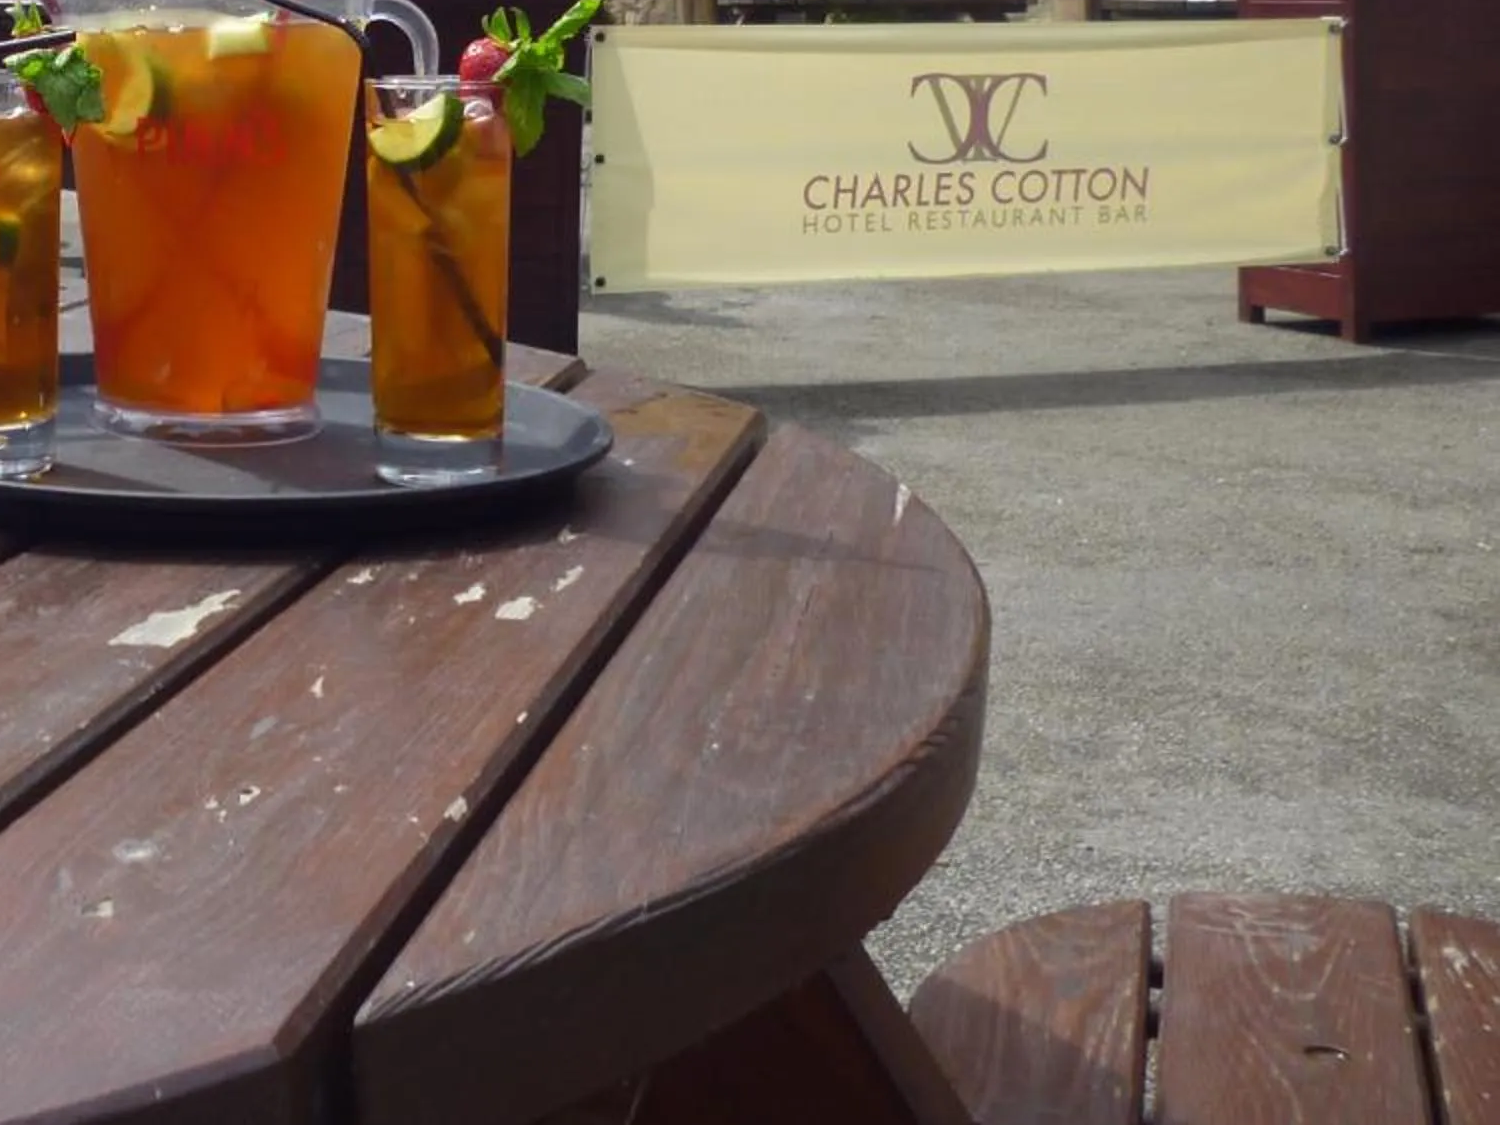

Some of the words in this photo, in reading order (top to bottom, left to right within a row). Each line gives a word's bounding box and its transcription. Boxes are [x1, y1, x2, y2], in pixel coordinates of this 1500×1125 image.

[803, 171, 975, 210] CHARLES
[990, 167, 1149, 204] COTTON
[802, 212, 893, 235] HOTEL
[907, 206, 1085, 231] RESTAURANT
[1099, 204, 1149, 225] BAR
